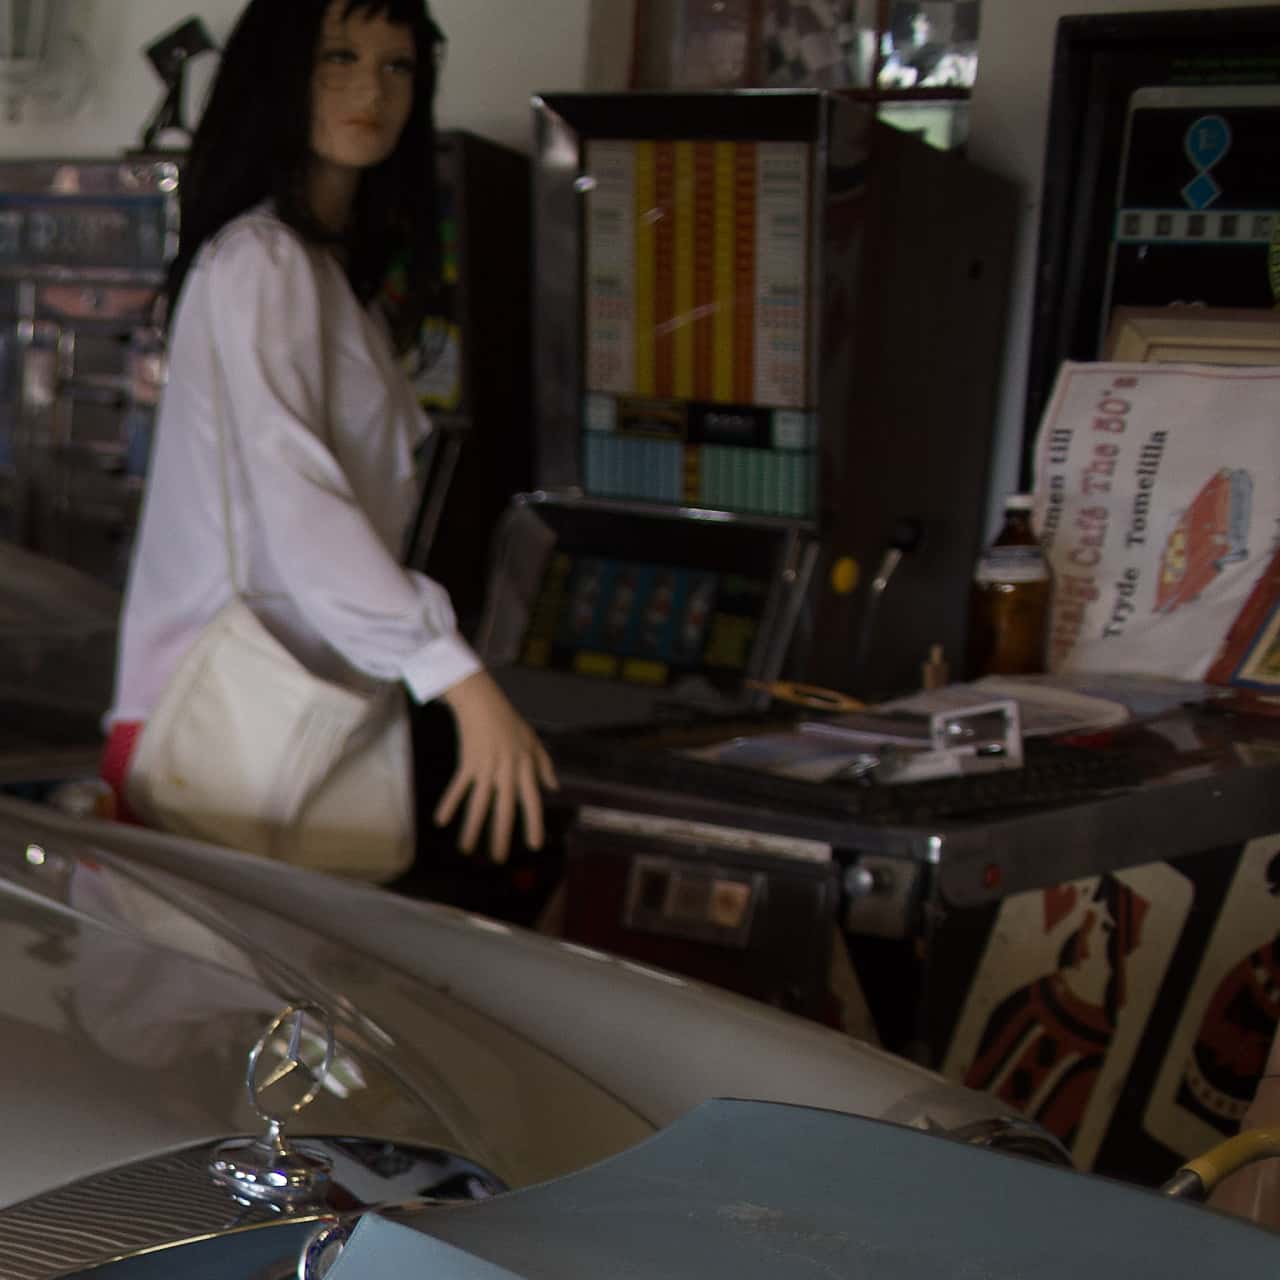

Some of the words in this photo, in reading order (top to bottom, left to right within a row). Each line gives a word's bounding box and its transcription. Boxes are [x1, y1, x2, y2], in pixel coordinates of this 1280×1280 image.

[1050, 427, 1073, 465] till
[1081, 443, 1120, 497] The
[1102, 566, 1141, 640] Tryde
[1125, 429, 1169, 548] Tomelilla
